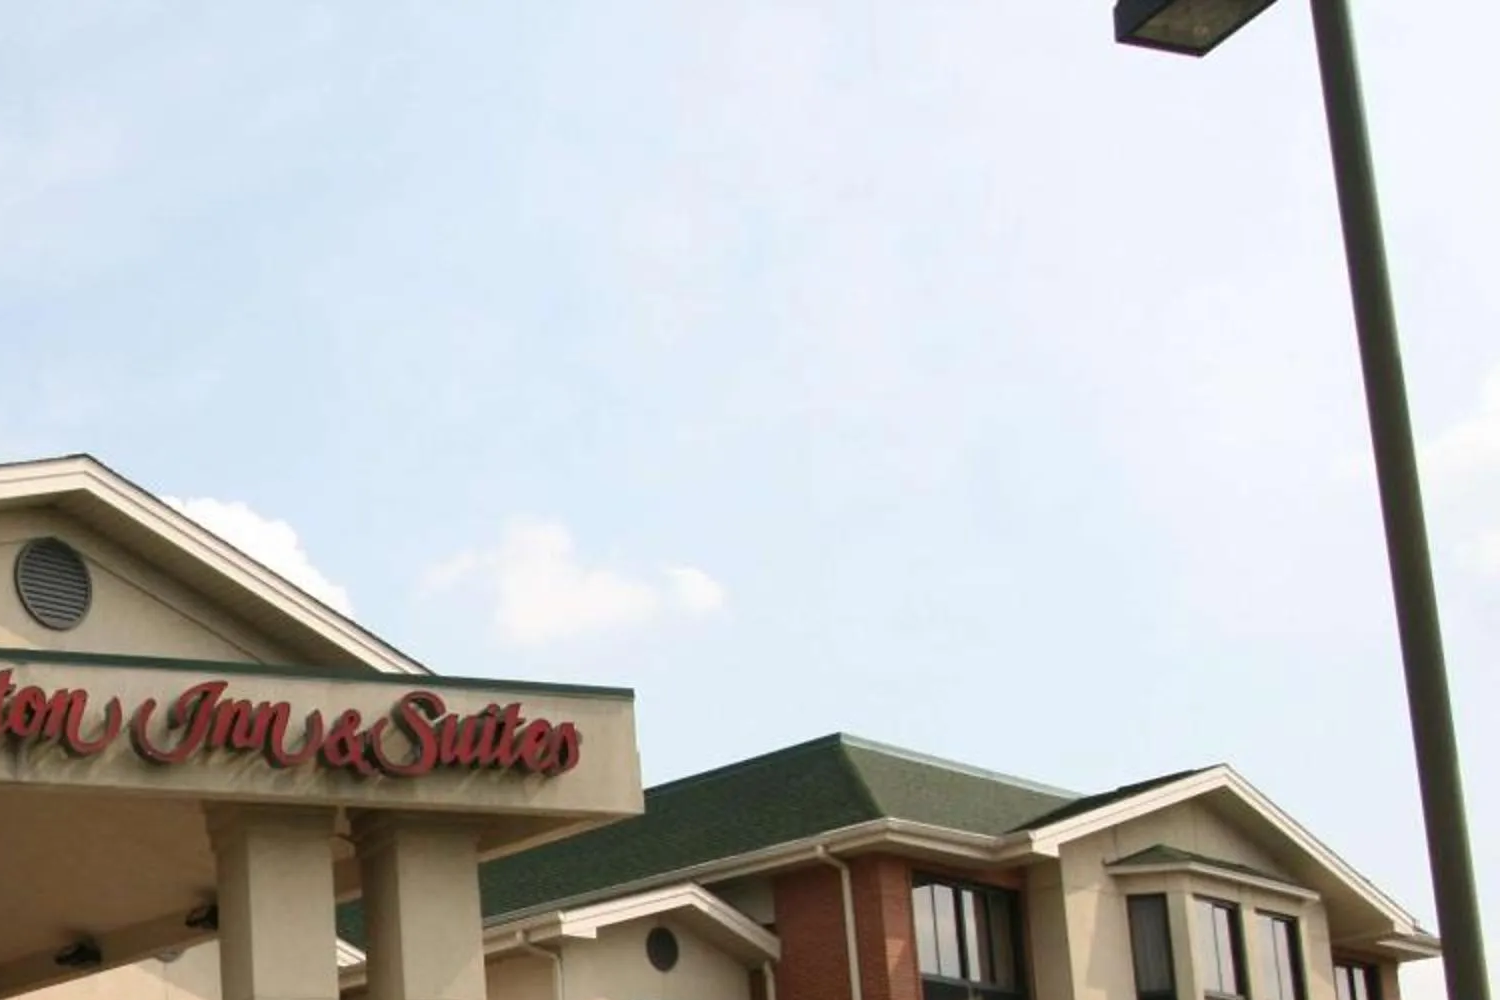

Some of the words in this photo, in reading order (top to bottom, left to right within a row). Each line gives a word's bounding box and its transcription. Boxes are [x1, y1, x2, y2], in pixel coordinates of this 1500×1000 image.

[130, 680, 323, 769] Inn
[320, 708, 374, 776] &
[370, 690, 582, 778] Suites
